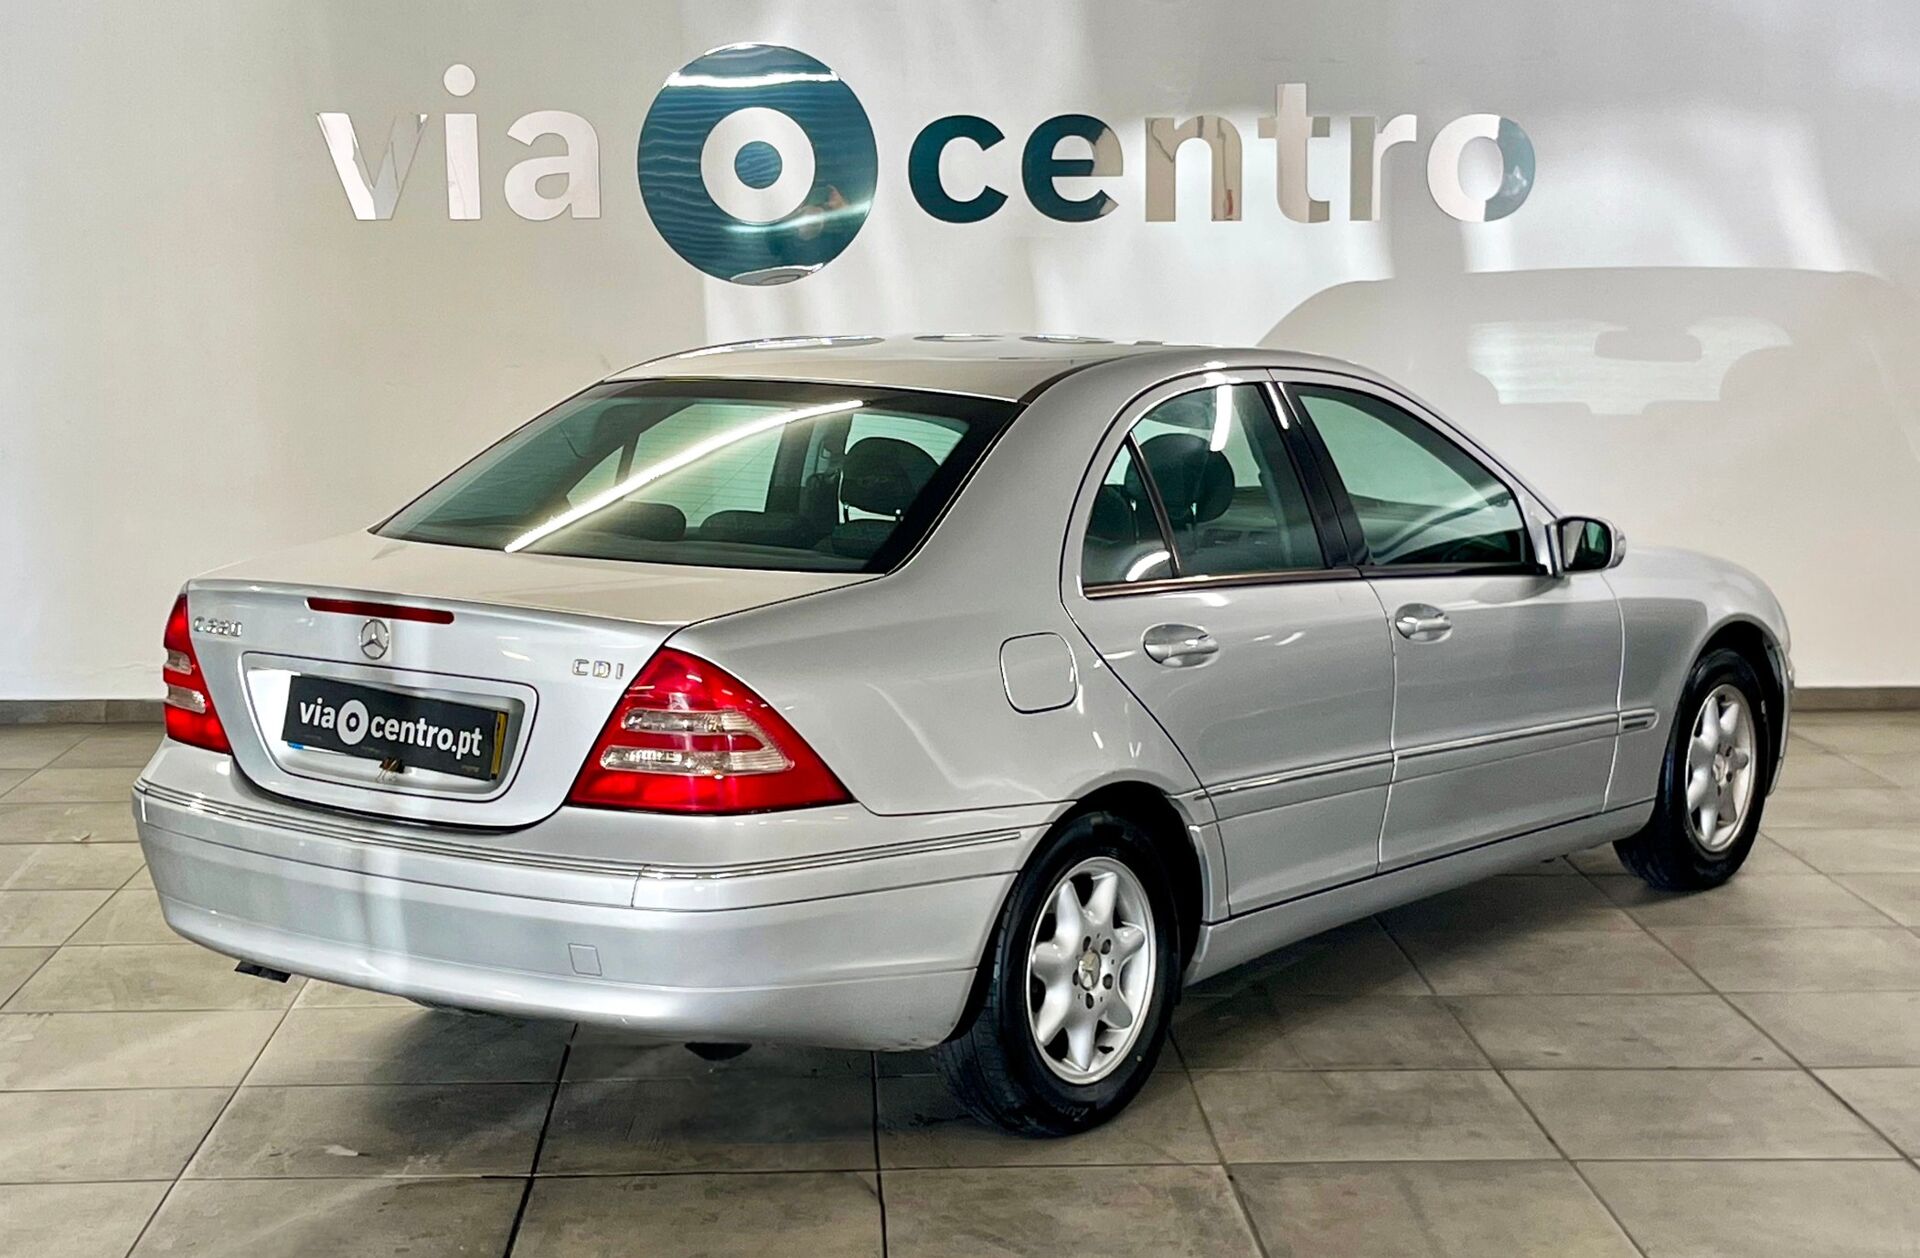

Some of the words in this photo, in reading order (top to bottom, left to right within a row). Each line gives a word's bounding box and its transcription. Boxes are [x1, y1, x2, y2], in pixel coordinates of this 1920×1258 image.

[318, 63, 601, 221] via
[909, 83, 1536, 223] centro
[572, 659, 624, 679] CDI
[300, 697, 336, 730] via
[370, 715, 483, 760] centro.pt
